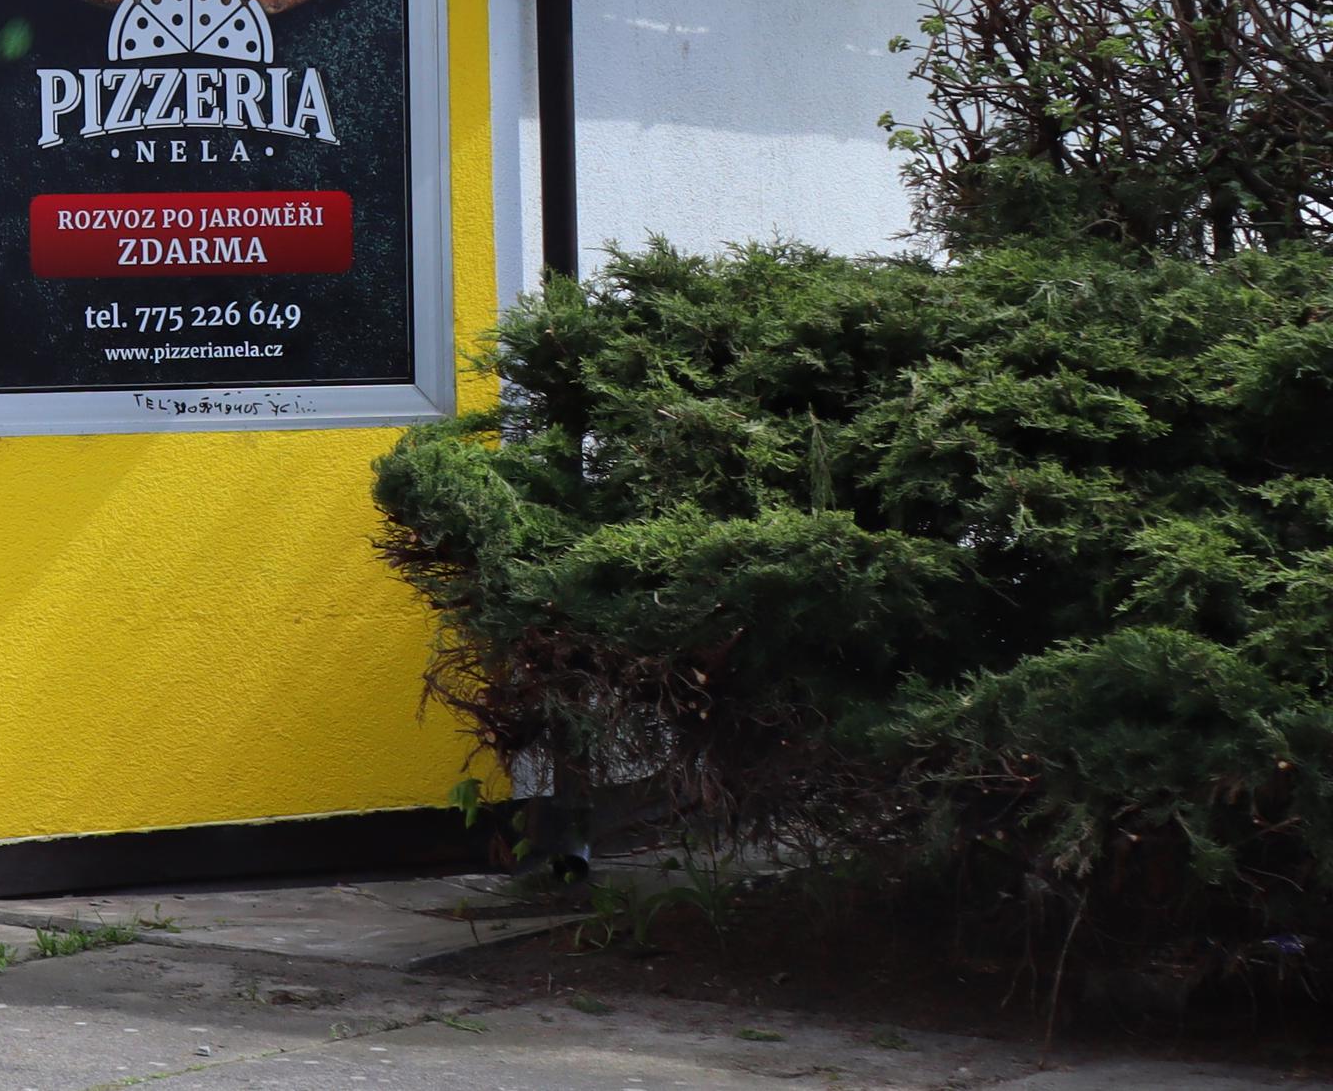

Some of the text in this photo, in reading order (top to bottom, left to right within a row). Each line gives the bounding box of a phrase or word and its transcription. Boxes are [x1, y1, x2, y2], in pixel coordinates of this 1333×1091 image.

[37, 66, 341, 149] PIZZERIA
[136, 139, 253, 163] NELA
[57, 202, 325, 231] ROZVOZ PO JAROMĚŘI
[117, 235, 268, 267] ZDARMA
[85, 301, 302, 333] tel. 775 226 649
[104, 341, 284, 363] www.pizzerianela.cz
